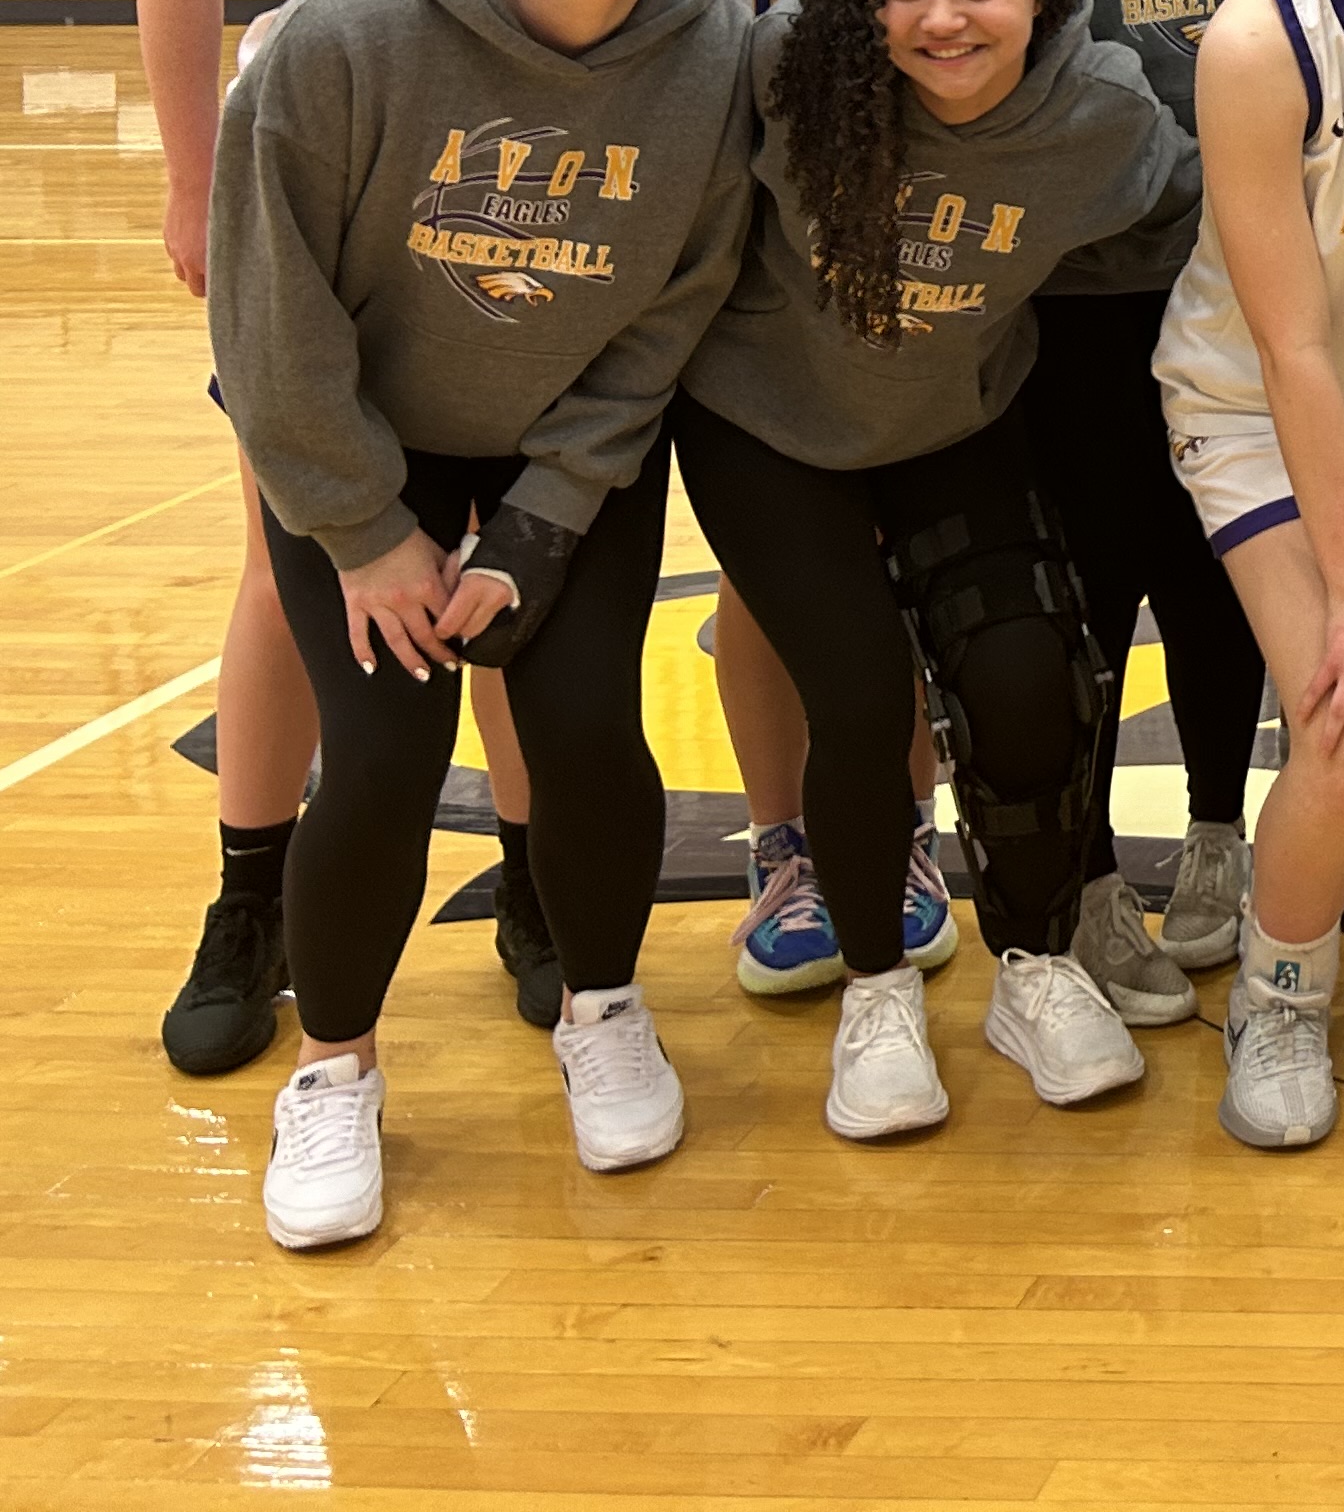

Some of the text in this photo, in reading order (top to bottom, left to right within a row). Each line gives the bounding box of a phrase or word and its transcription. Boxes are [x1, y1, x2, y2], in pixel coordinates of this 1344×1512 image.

[430, 129, 640, 200] AVON
[481, 193, 571, 224] EAGLES
[407, 223, 613, 275] BASKETBALL
